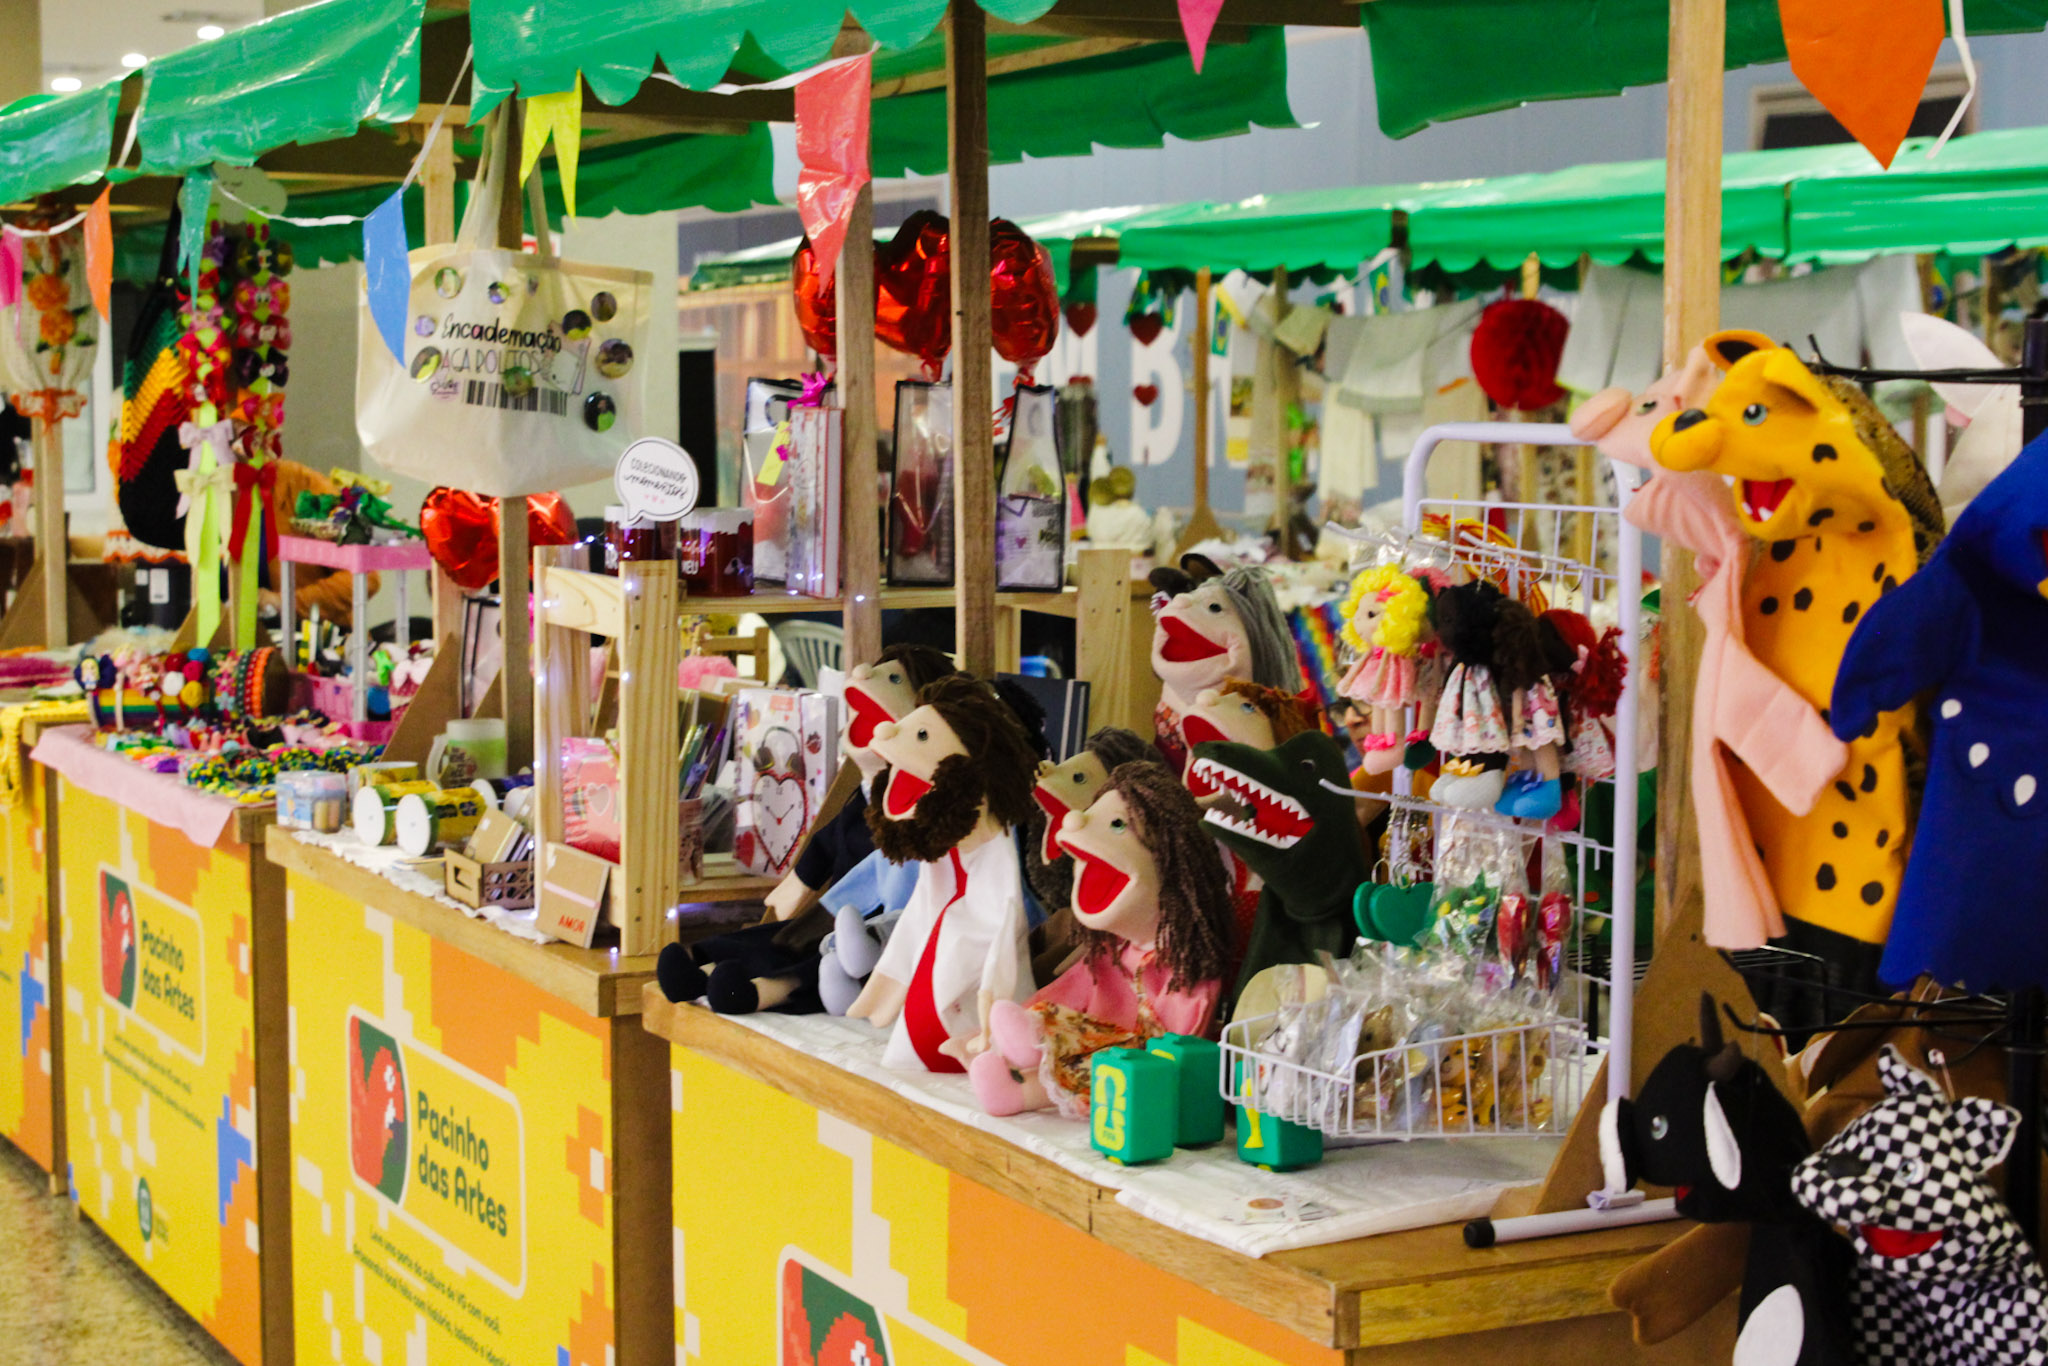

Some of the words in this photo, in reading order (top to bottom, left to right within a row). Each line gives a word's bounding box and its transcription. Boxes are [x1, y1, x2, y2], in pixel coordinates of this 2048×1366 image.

[142, 919, 185, 973] Pacinho
[557, 914, 585, 934] AMOR
[142, 960, 161, 999] das
[164, 972, 196, 1022] Artes
[417, 1090, 489, 1171] Pacinho
[418, 1143, 449, 1200] das
[454, 1166, 507, 1238] Artes
